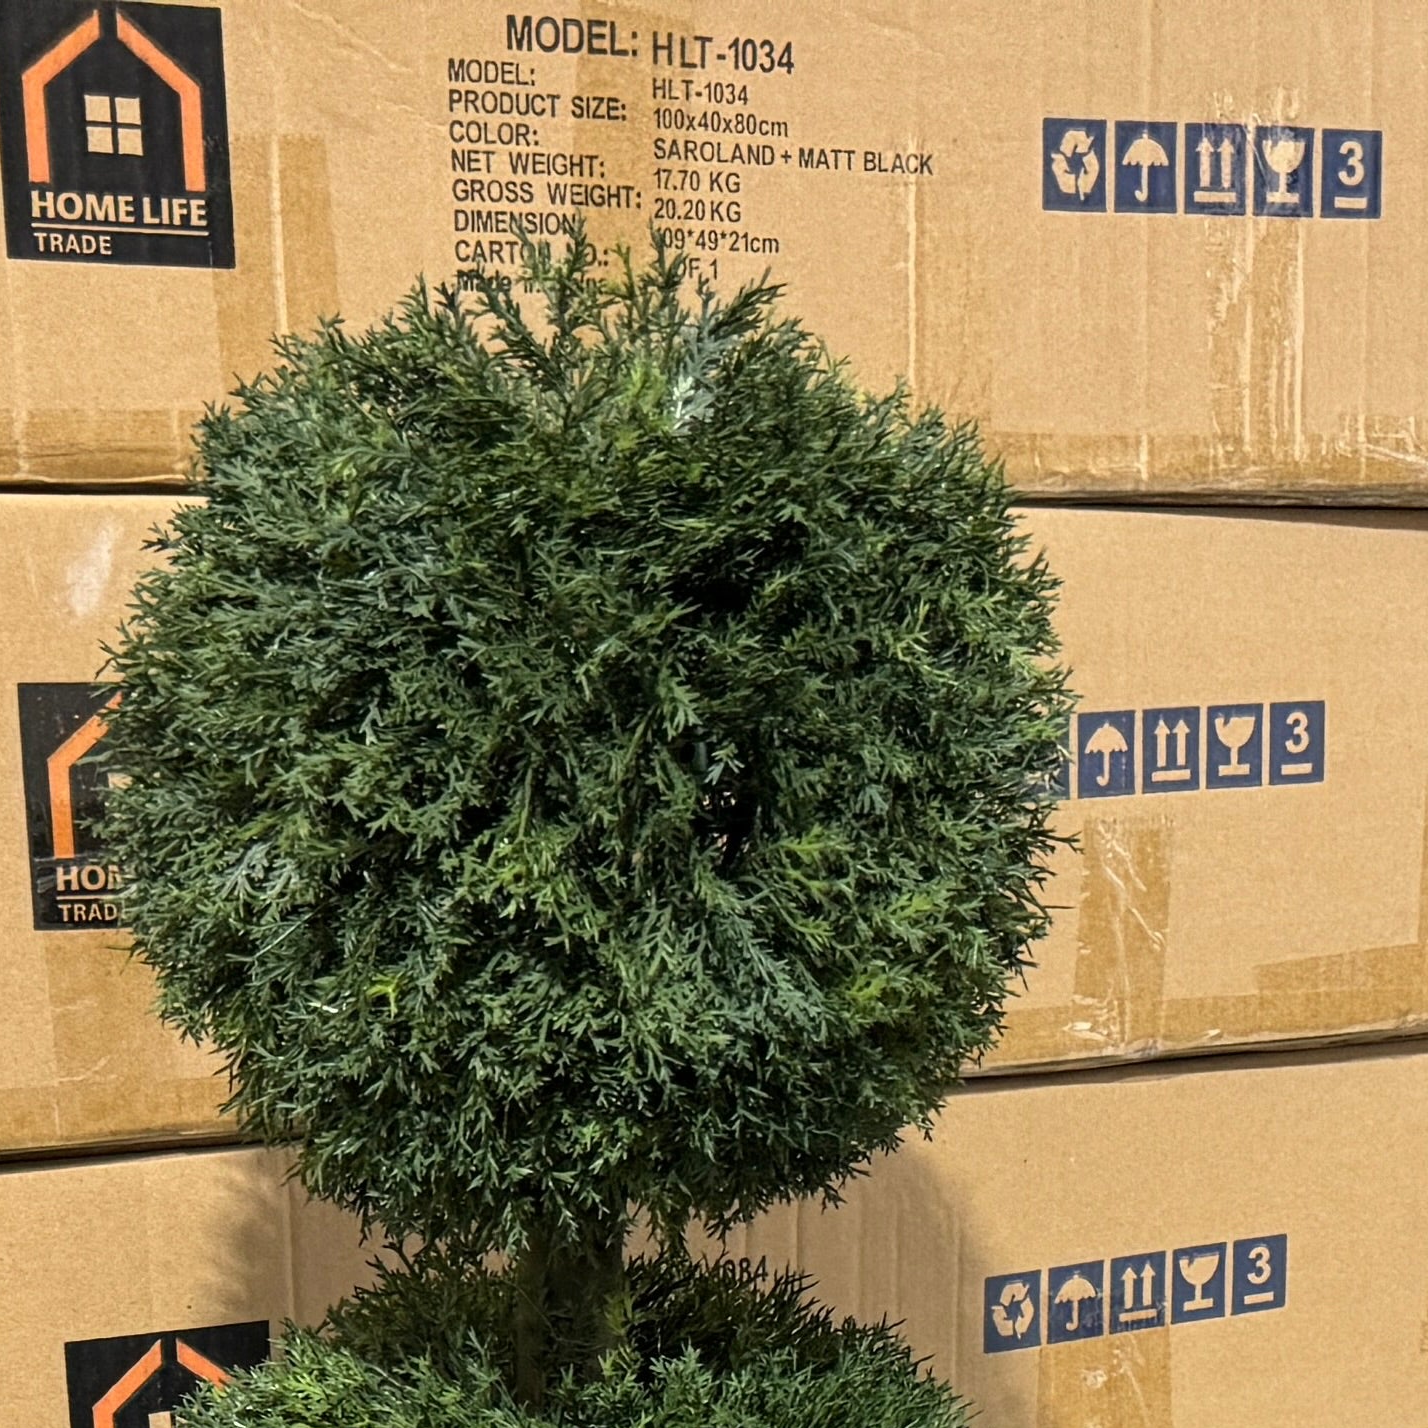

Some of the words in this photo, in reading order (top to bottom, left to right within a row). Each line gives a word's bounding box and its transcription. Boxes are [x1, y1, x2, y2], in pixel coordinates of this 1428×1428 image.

[506, 15, 638, 57] MODEL:
[653, 31, 795, 75] HLT-1034
[448, 58, 536, 86] MODEL:
[652, 78, 749, 106] HLT-1034
[449, 89, 561, 118] PRODUCT
[571, 95, 627, 122] SIZE:
[653, 108, 789, 138] 100x40x80cm
[449, 120, 540, 147] COLOR:
[653, 138, 775, 166] SAROLAND
[798, 147, 856, 171] MATT
[864, 152, 934, 175] BLACK
[1336, 140, 1366, 187] 3
[451, 149, 496, 174] NET
[509, 152, 606, 179] WEIGHT:
[653, 168, 701, 192] 17.70
[709, 171, 742, 194] KG
[30, 189, 136, 223] HOME
[142, 196, 208, 227] LIFE
[452, 179, 535, 204] GROSS
[547, 182, 642, 209] WEIGHT:
[654, 198, 706, 221] 20.20
[710, 201, 742, 223] KG
[33, 232, 113, 255] TRADE
[1284, 711, 1310, 754] 3
[58, 903, 118, 922] TRAD
[1246, 1246, 1272, 1285] 3
